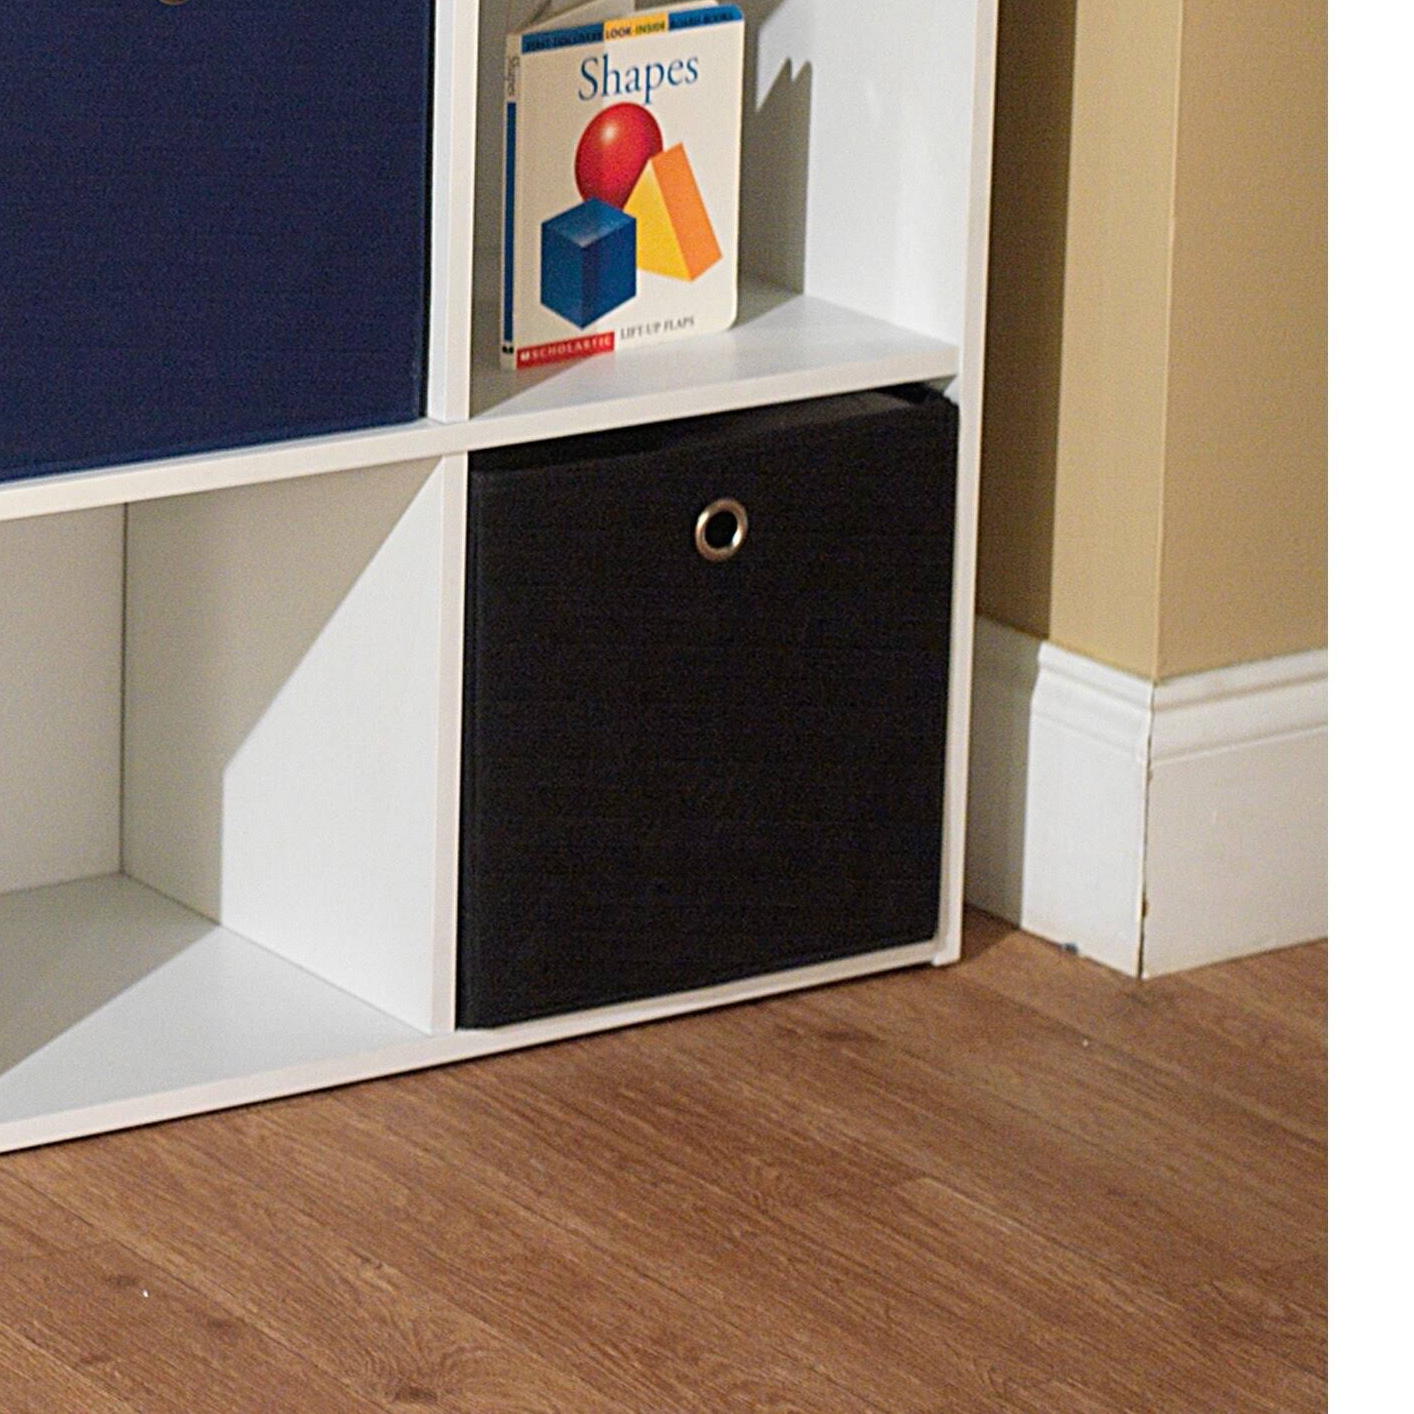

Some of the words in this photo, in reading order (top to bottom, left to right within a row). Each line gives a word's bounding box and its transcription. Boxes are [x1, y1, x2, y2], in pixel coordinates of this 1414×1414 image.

[605, 26, 632, 39] LOOK
[578, 52, 699, 104] Shapes
[531, 335, 611, 360] SCHOLASTIC
